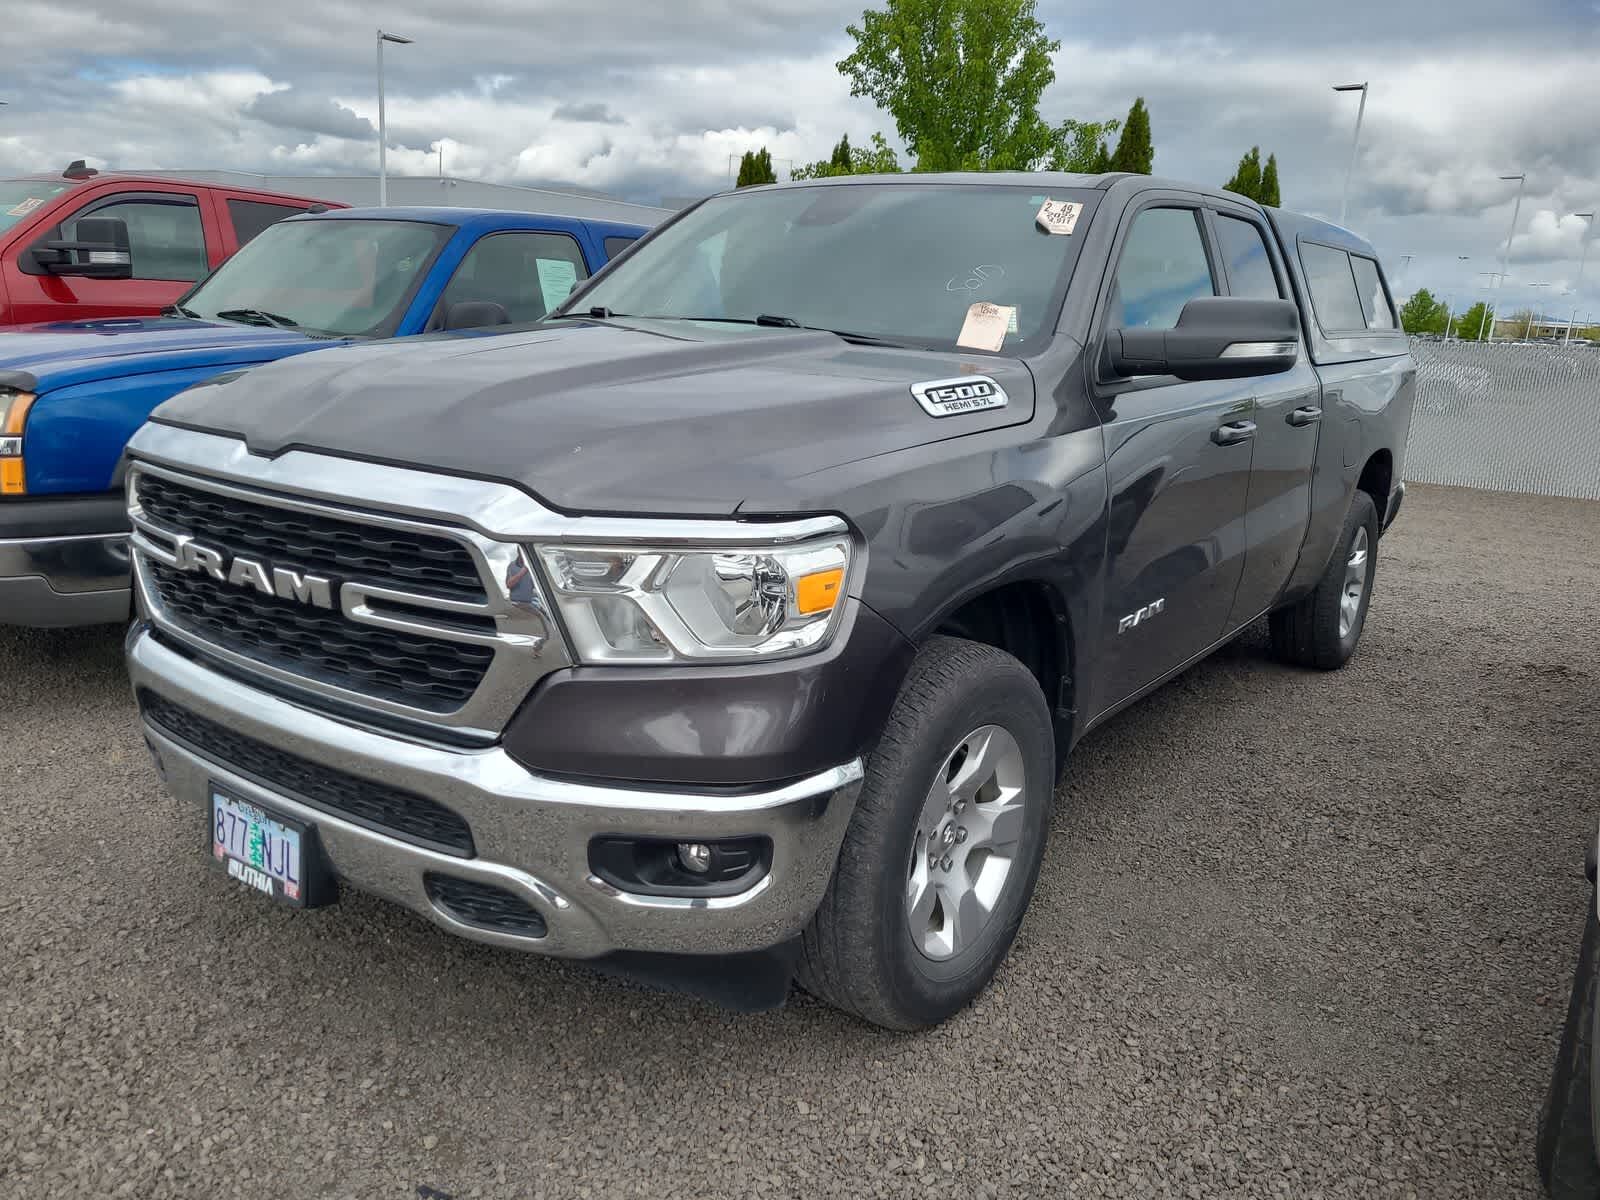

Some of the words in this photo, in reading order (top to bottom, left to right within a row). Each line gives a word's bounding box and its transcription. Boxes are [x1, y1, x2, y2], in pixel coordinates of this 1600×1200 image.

[926, 383, 992, 404] 1500
[944, 400, 972, 412] HEMI
[972, 398, 995, 407] 5.7L
[184, 541, 332, 609] RAM
[1118, 598, 1165, 634] RAM
[217, 807, 248, 857] 877
[262, 829, 298, 884] NJL
